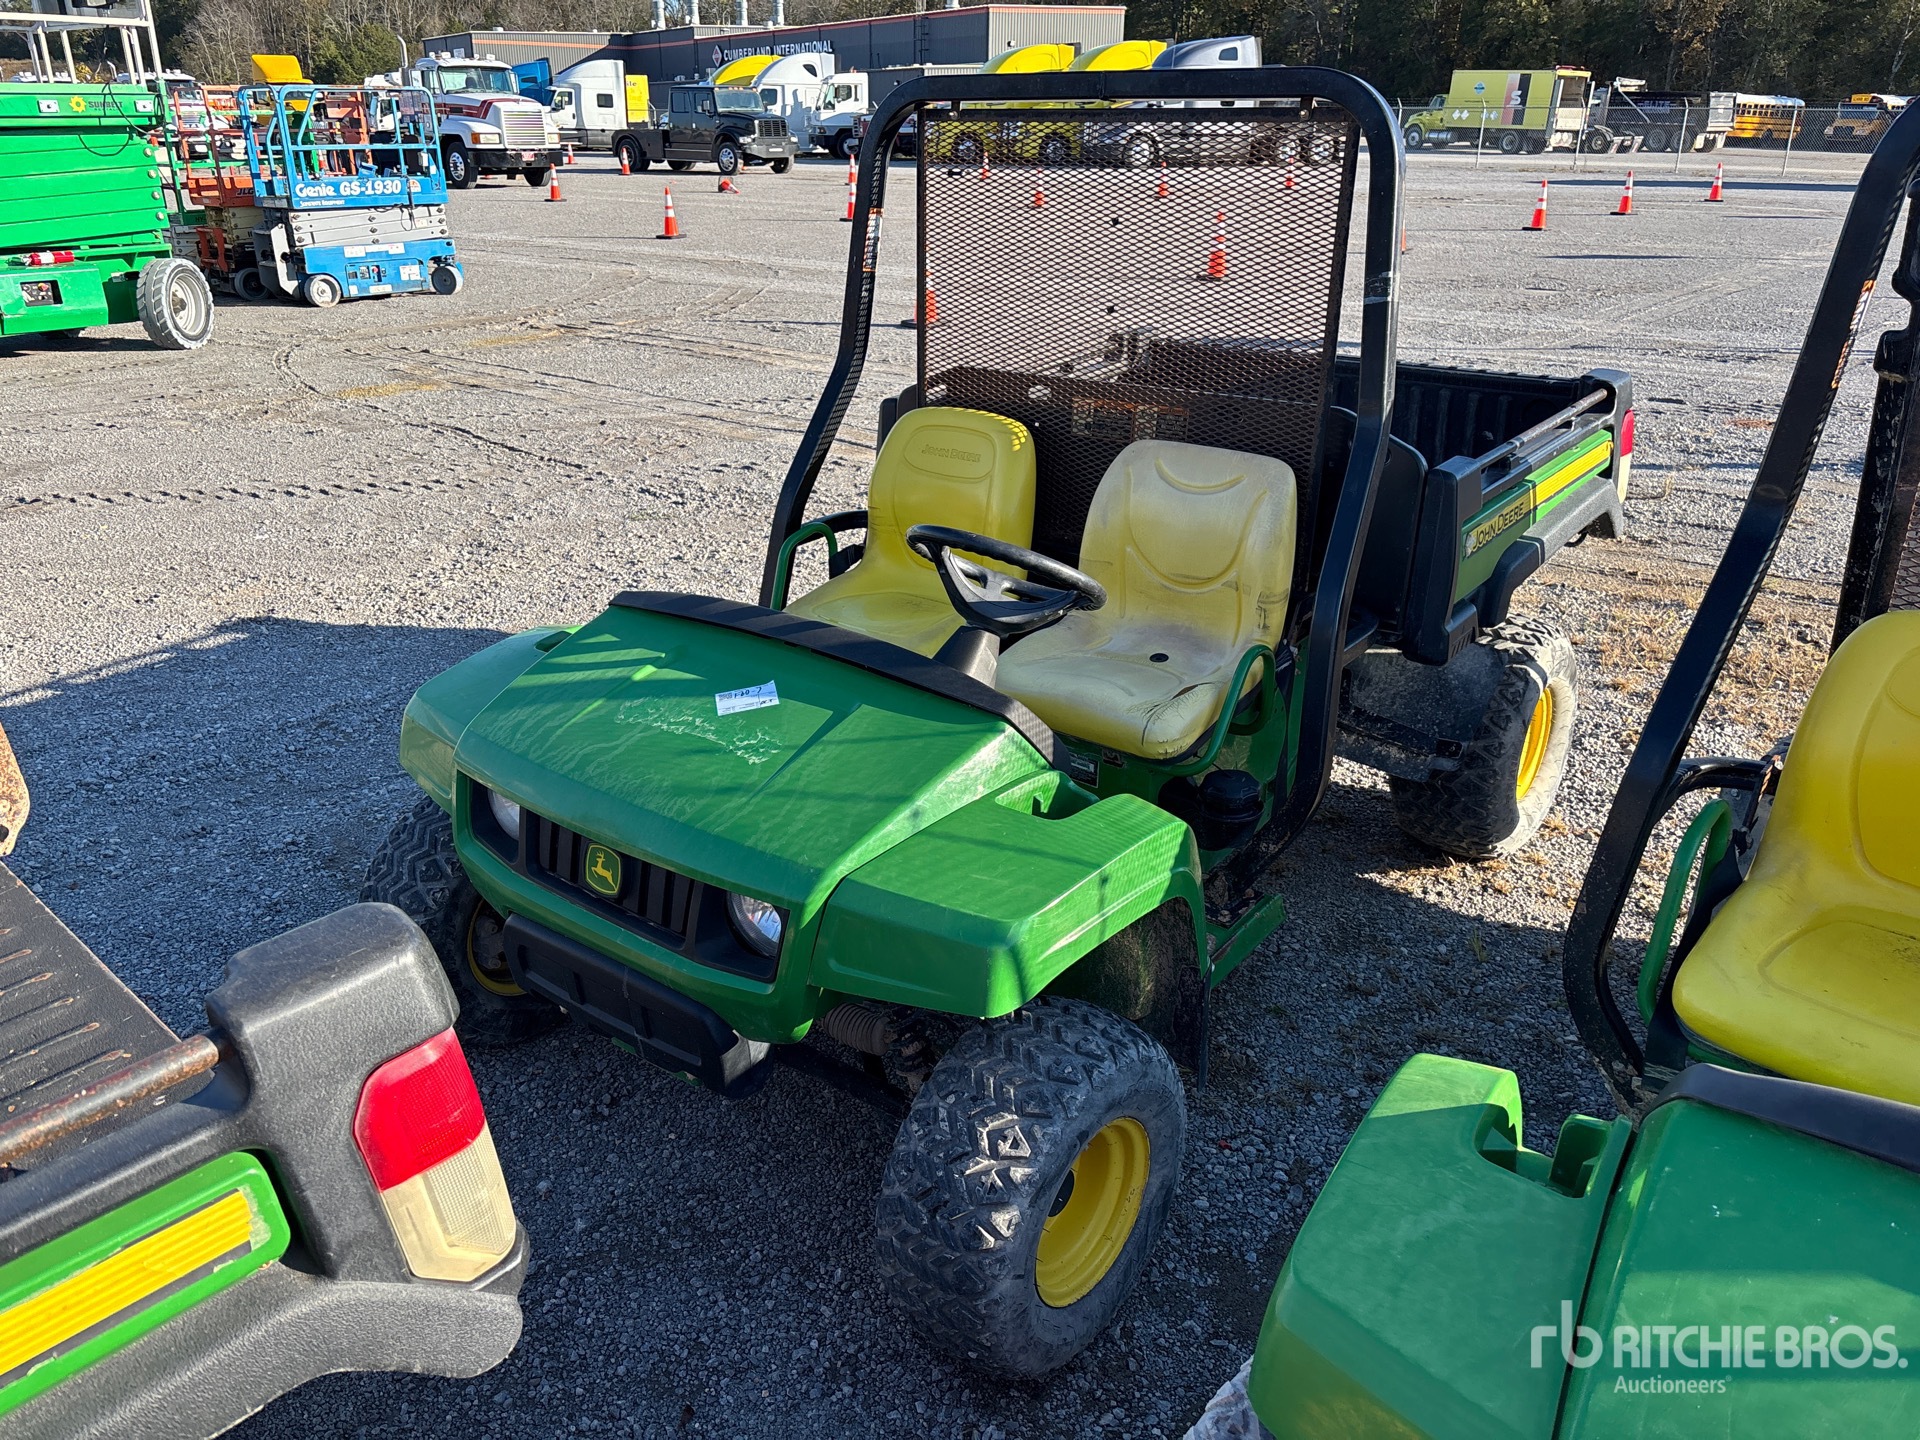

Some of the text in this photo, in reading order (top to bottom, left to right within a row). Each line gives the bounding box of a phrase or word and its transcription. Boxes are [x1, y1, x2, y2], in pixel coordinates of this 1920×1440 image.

[723, 40, 833, 61] CUMBERLAND INTERNATIONAL
[295, 183, 337, 198] Genie
[339, 179, 402, 196] GS-1930
[1472, 502, 1525, 551] JOHN DEERE
